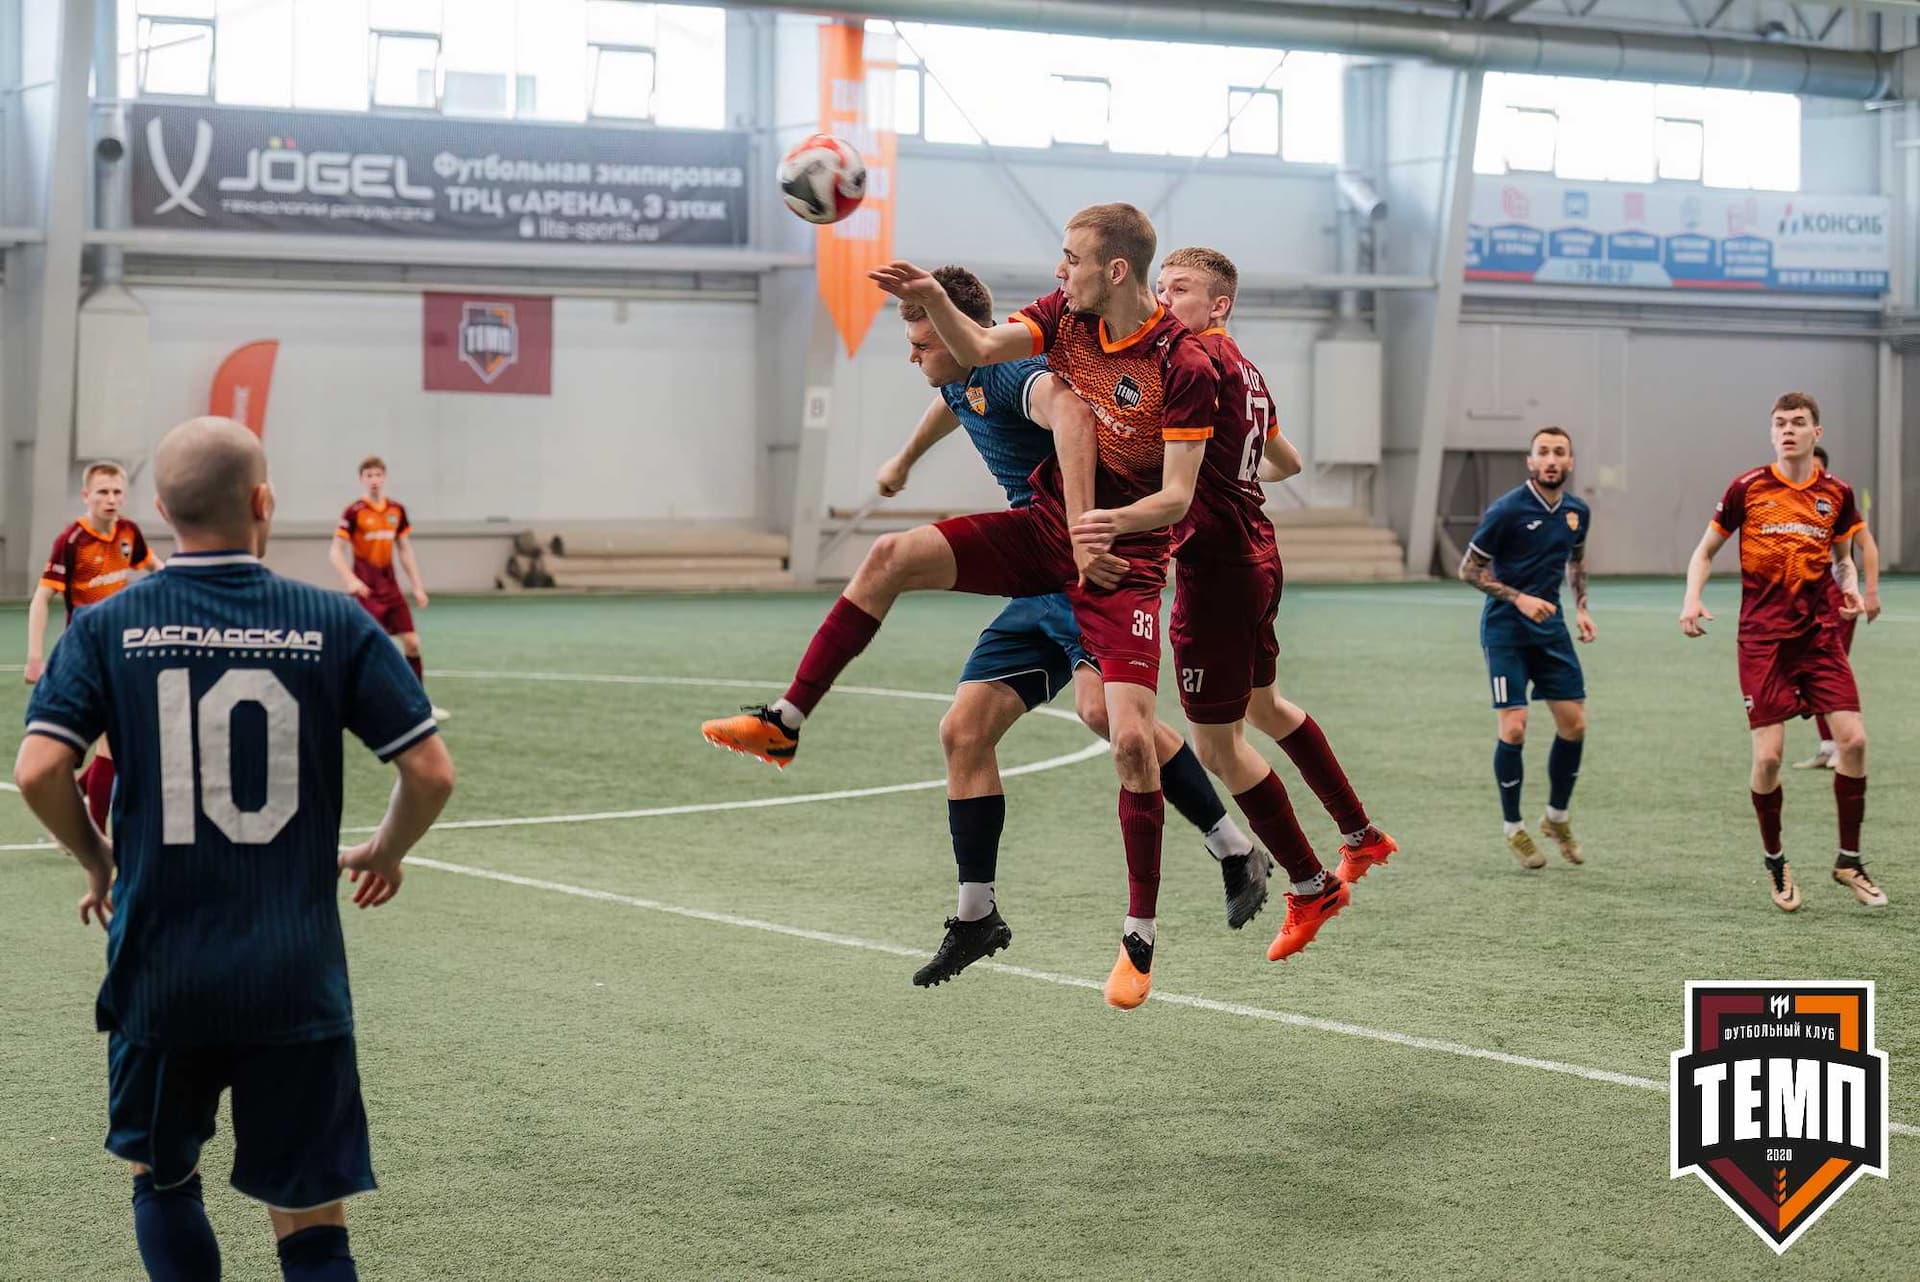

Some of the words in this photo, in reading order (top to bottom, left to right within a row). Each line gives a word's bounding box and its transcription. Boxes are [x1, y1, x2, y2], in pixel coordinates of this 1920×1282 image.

[218, 136, 435, 200] JÖGEL
[433, 152, 590, 185] Футбольная
[596, 163, 743, 192] экипировка
[445, 186, 504, 218] ТРЦ
[507, 189, 641, 221] «АРЕНА»,
[643, 193, 663, 219] 3
[1802, 213, 1883, 235] КОНСИБ
[1116, 384, 1139, 406] ТЕМП
[1131, 609, 1154, 640] 33
[1182, 668, 1205, 693] 27
[1493, 675, 1508, 703] 11
[157, 667, 300, 845] 10
